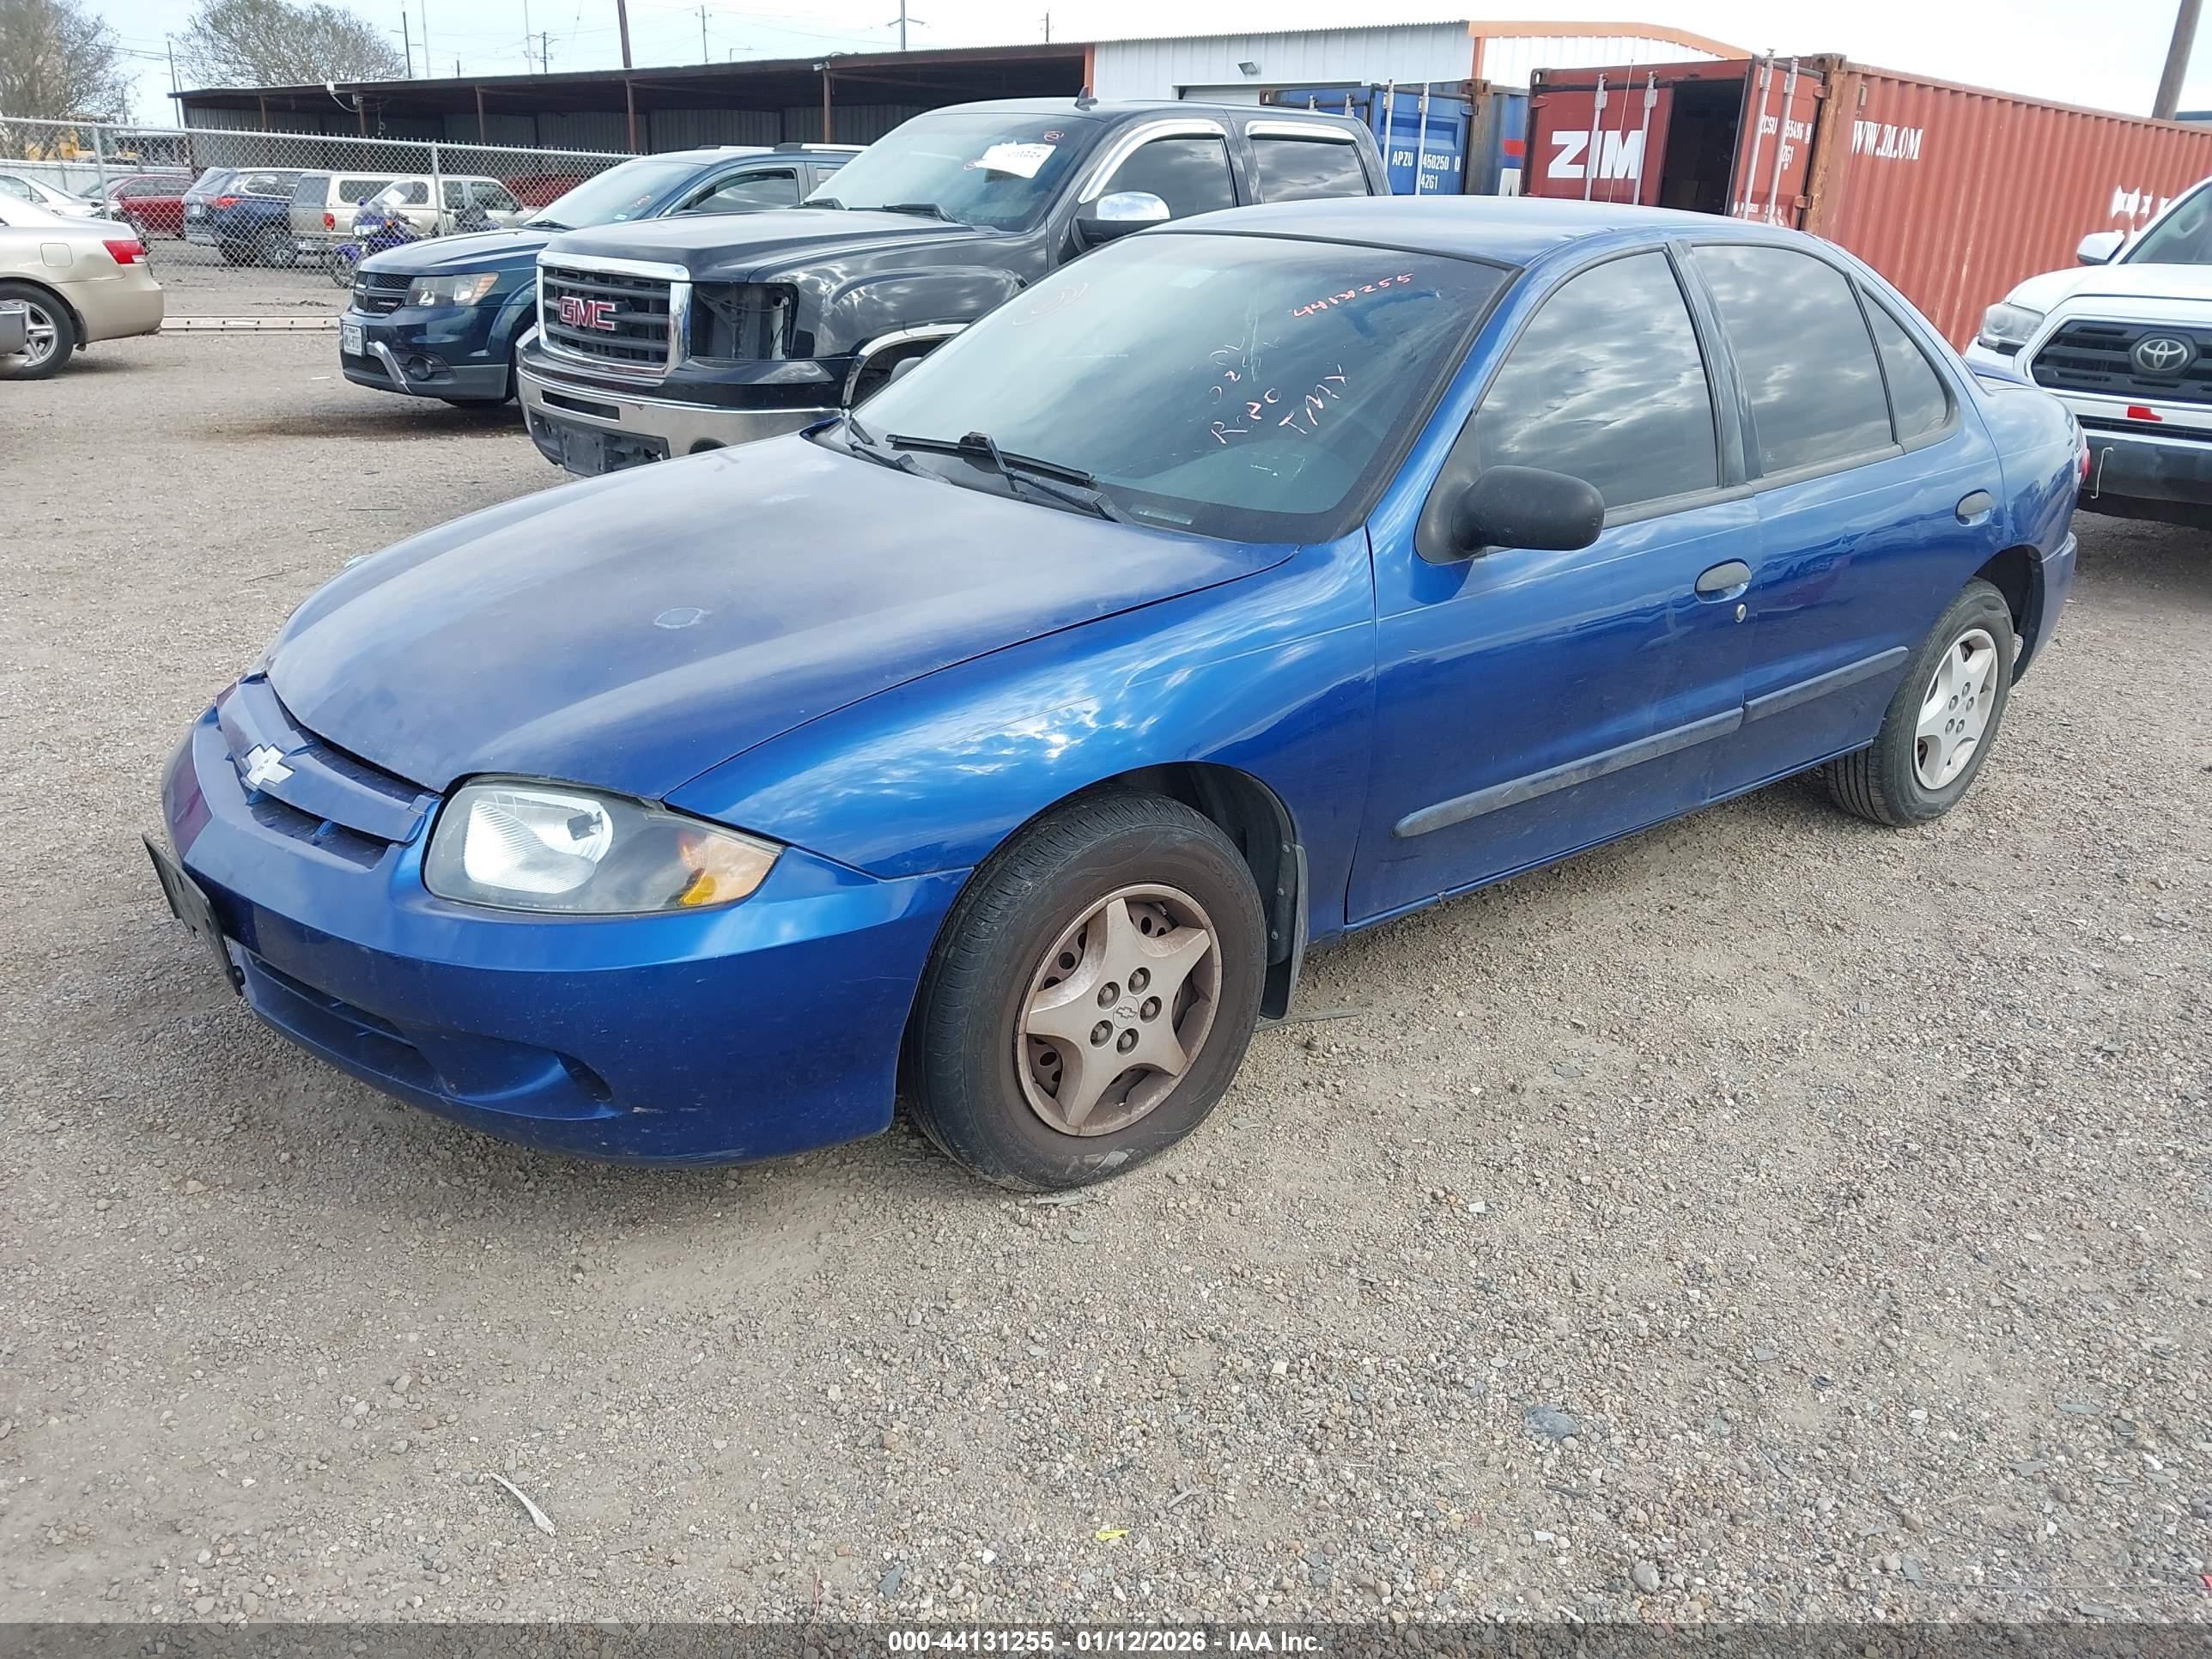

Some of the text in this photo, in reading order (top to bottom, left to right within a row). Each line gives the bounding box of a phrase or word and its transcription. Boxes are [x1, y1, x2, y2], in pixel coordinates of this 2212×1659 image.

[1392, 150, 1414, 167] APZU
[1422, 154, 1449, 170] 450250
[1547, 130, 1644, 179] ZIM
[560, 295, 617, 331] GMC
